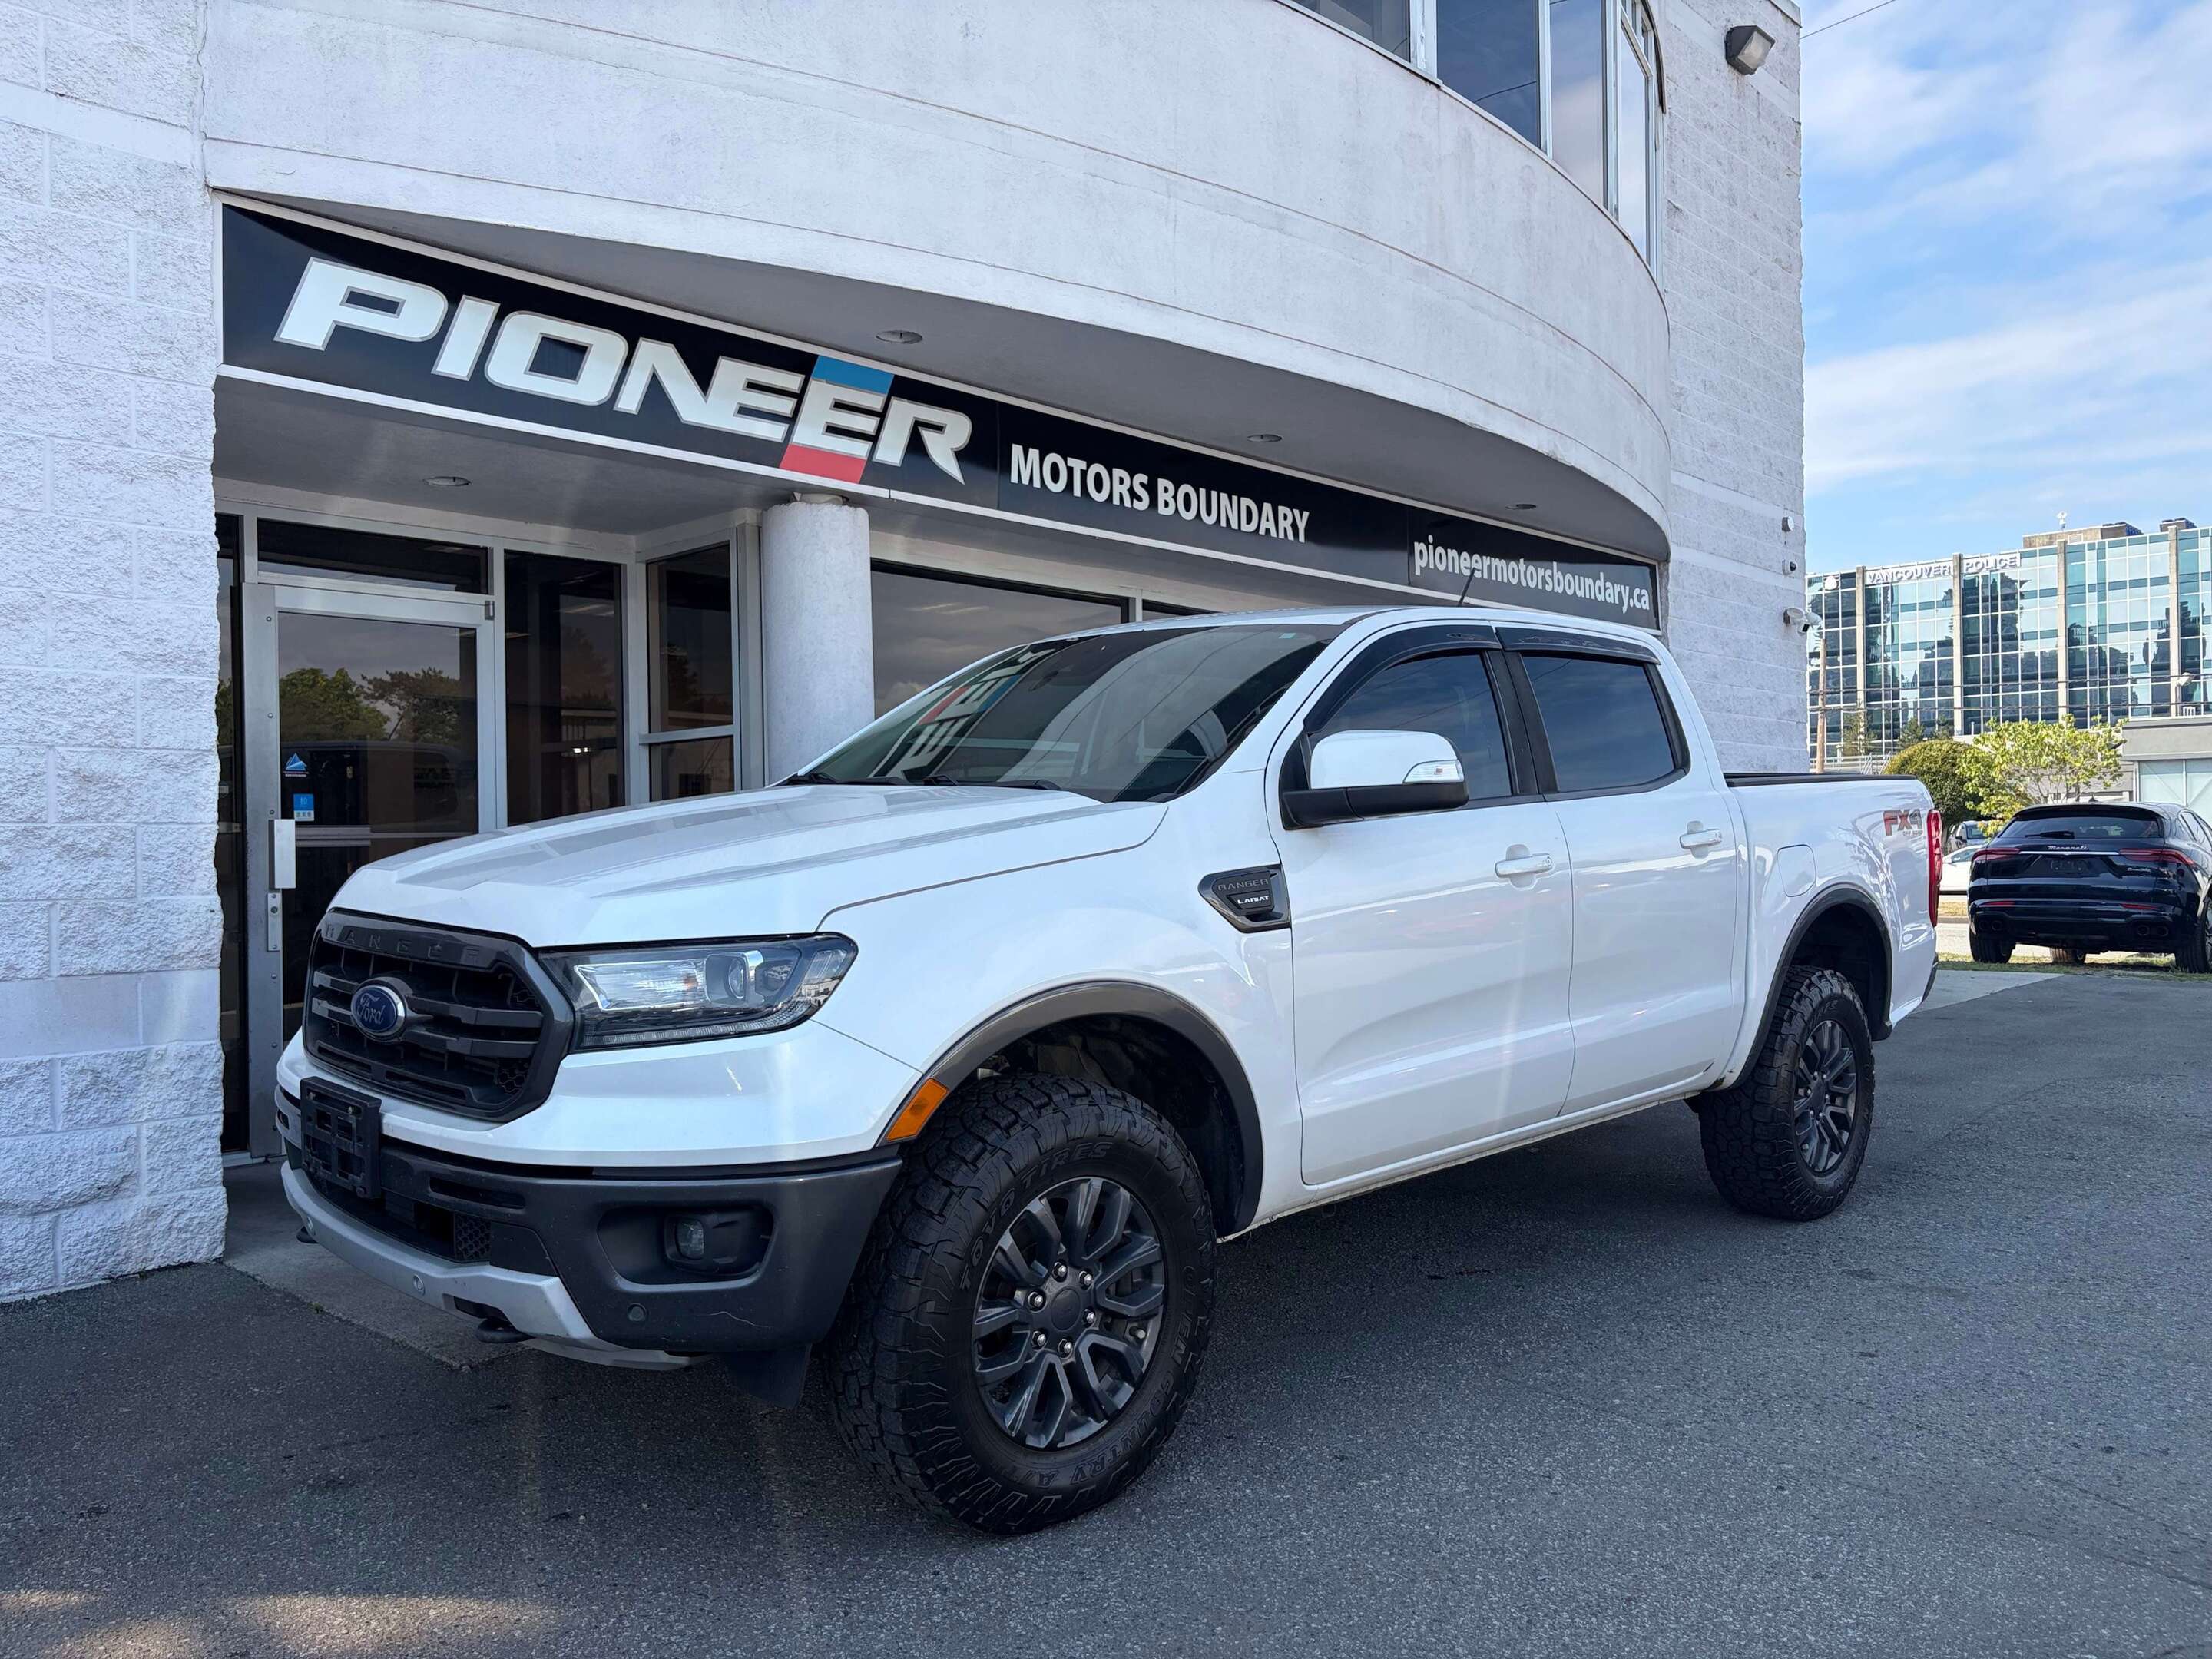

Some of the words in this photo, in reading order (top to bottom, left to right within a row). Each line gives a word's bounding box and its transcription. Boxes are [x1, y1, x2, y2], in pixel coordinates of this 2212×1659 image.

[273, 257, 972, 485] PIONEER
[1010, 443, 1150, 511] MOTORS
[1157, 478, 1310, 543] BOUNDARY
[1414, 535, 1650, 614] pioneermotorsboundary.ca
[1867, 564, 1953, 584] VANCOUVER
[1964, 555, 2018, 574] POLICE
[1883, 809, 1922, 836] FX4
[1217, 878, 1269, 891] RANGER
[1237, 896, 1270, 905] LARIAT
[356, 992, 386, 1025] Ford
[1020, 1141, 1113, 1189] TIRES
